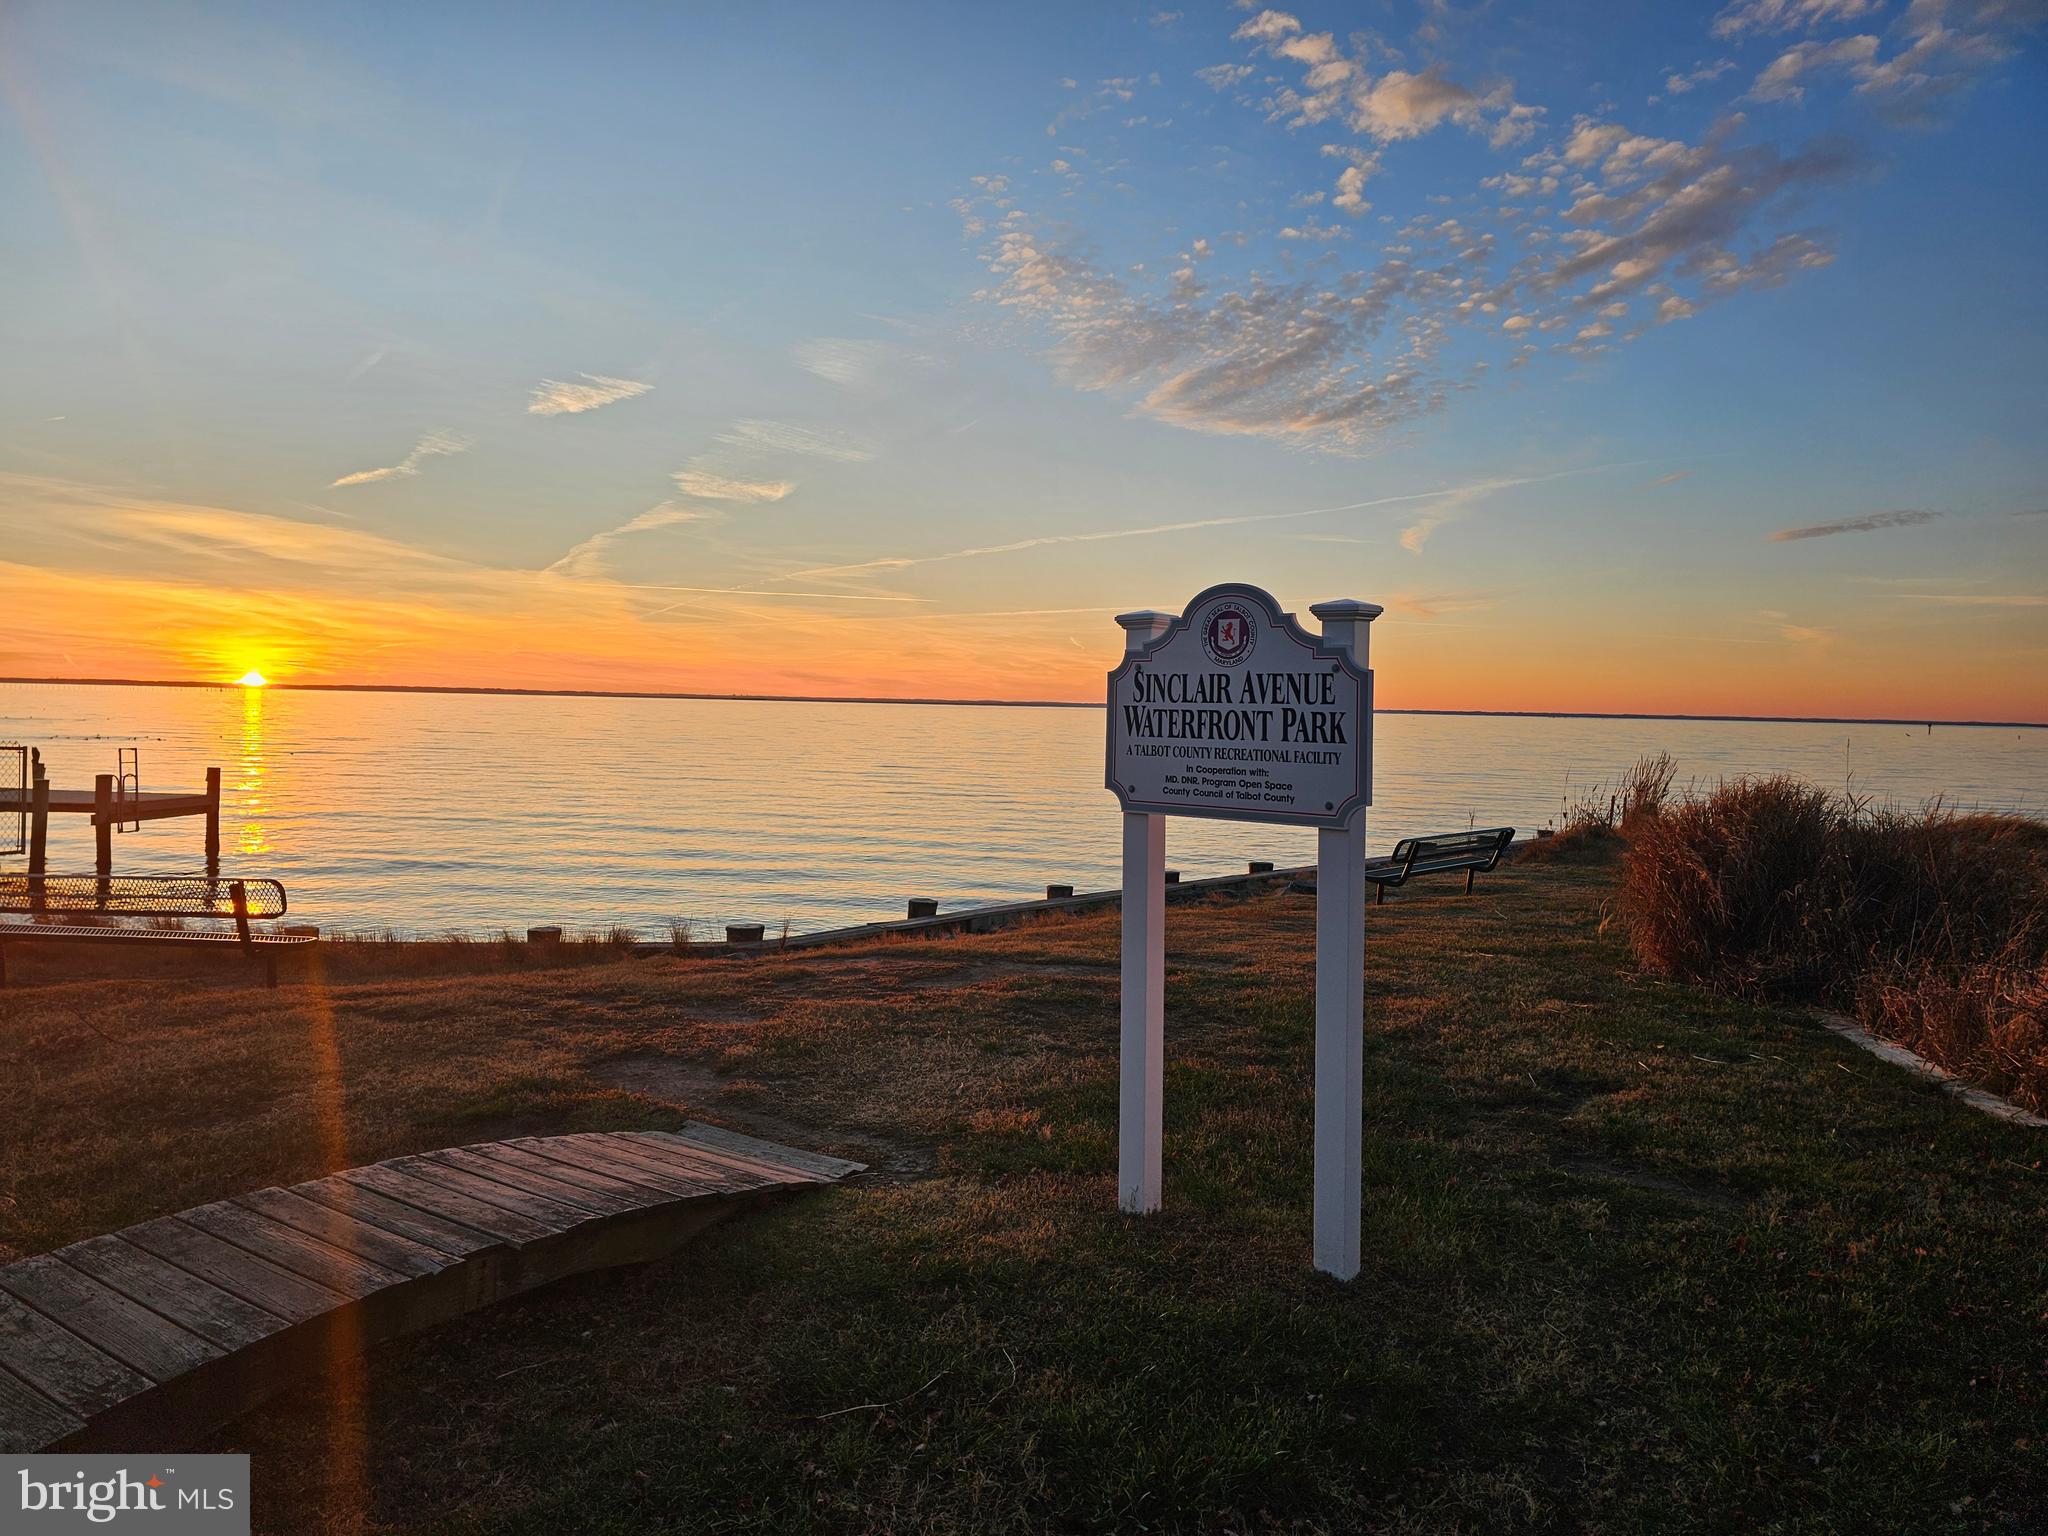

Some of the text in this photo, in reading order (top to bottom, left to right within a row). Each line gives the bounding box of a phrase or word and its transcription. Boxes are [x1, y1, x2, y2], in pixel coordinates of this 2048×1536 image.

[1133, 670, 1335, 705] SINCLAIR AVENUE
[1124, 705, 1347, 744] WATERFRONT PARK
[1126, 745, 1341, 765] A TALBOT COUNTY RECREATIONAL FACILITY
[1186, 765, 1269, 777] In Cooperation with:
[1165, 776, 1292, 791] MD. DNR. Program Open Space
[1163, 787, 1295, 804] County Council of Talbot County
